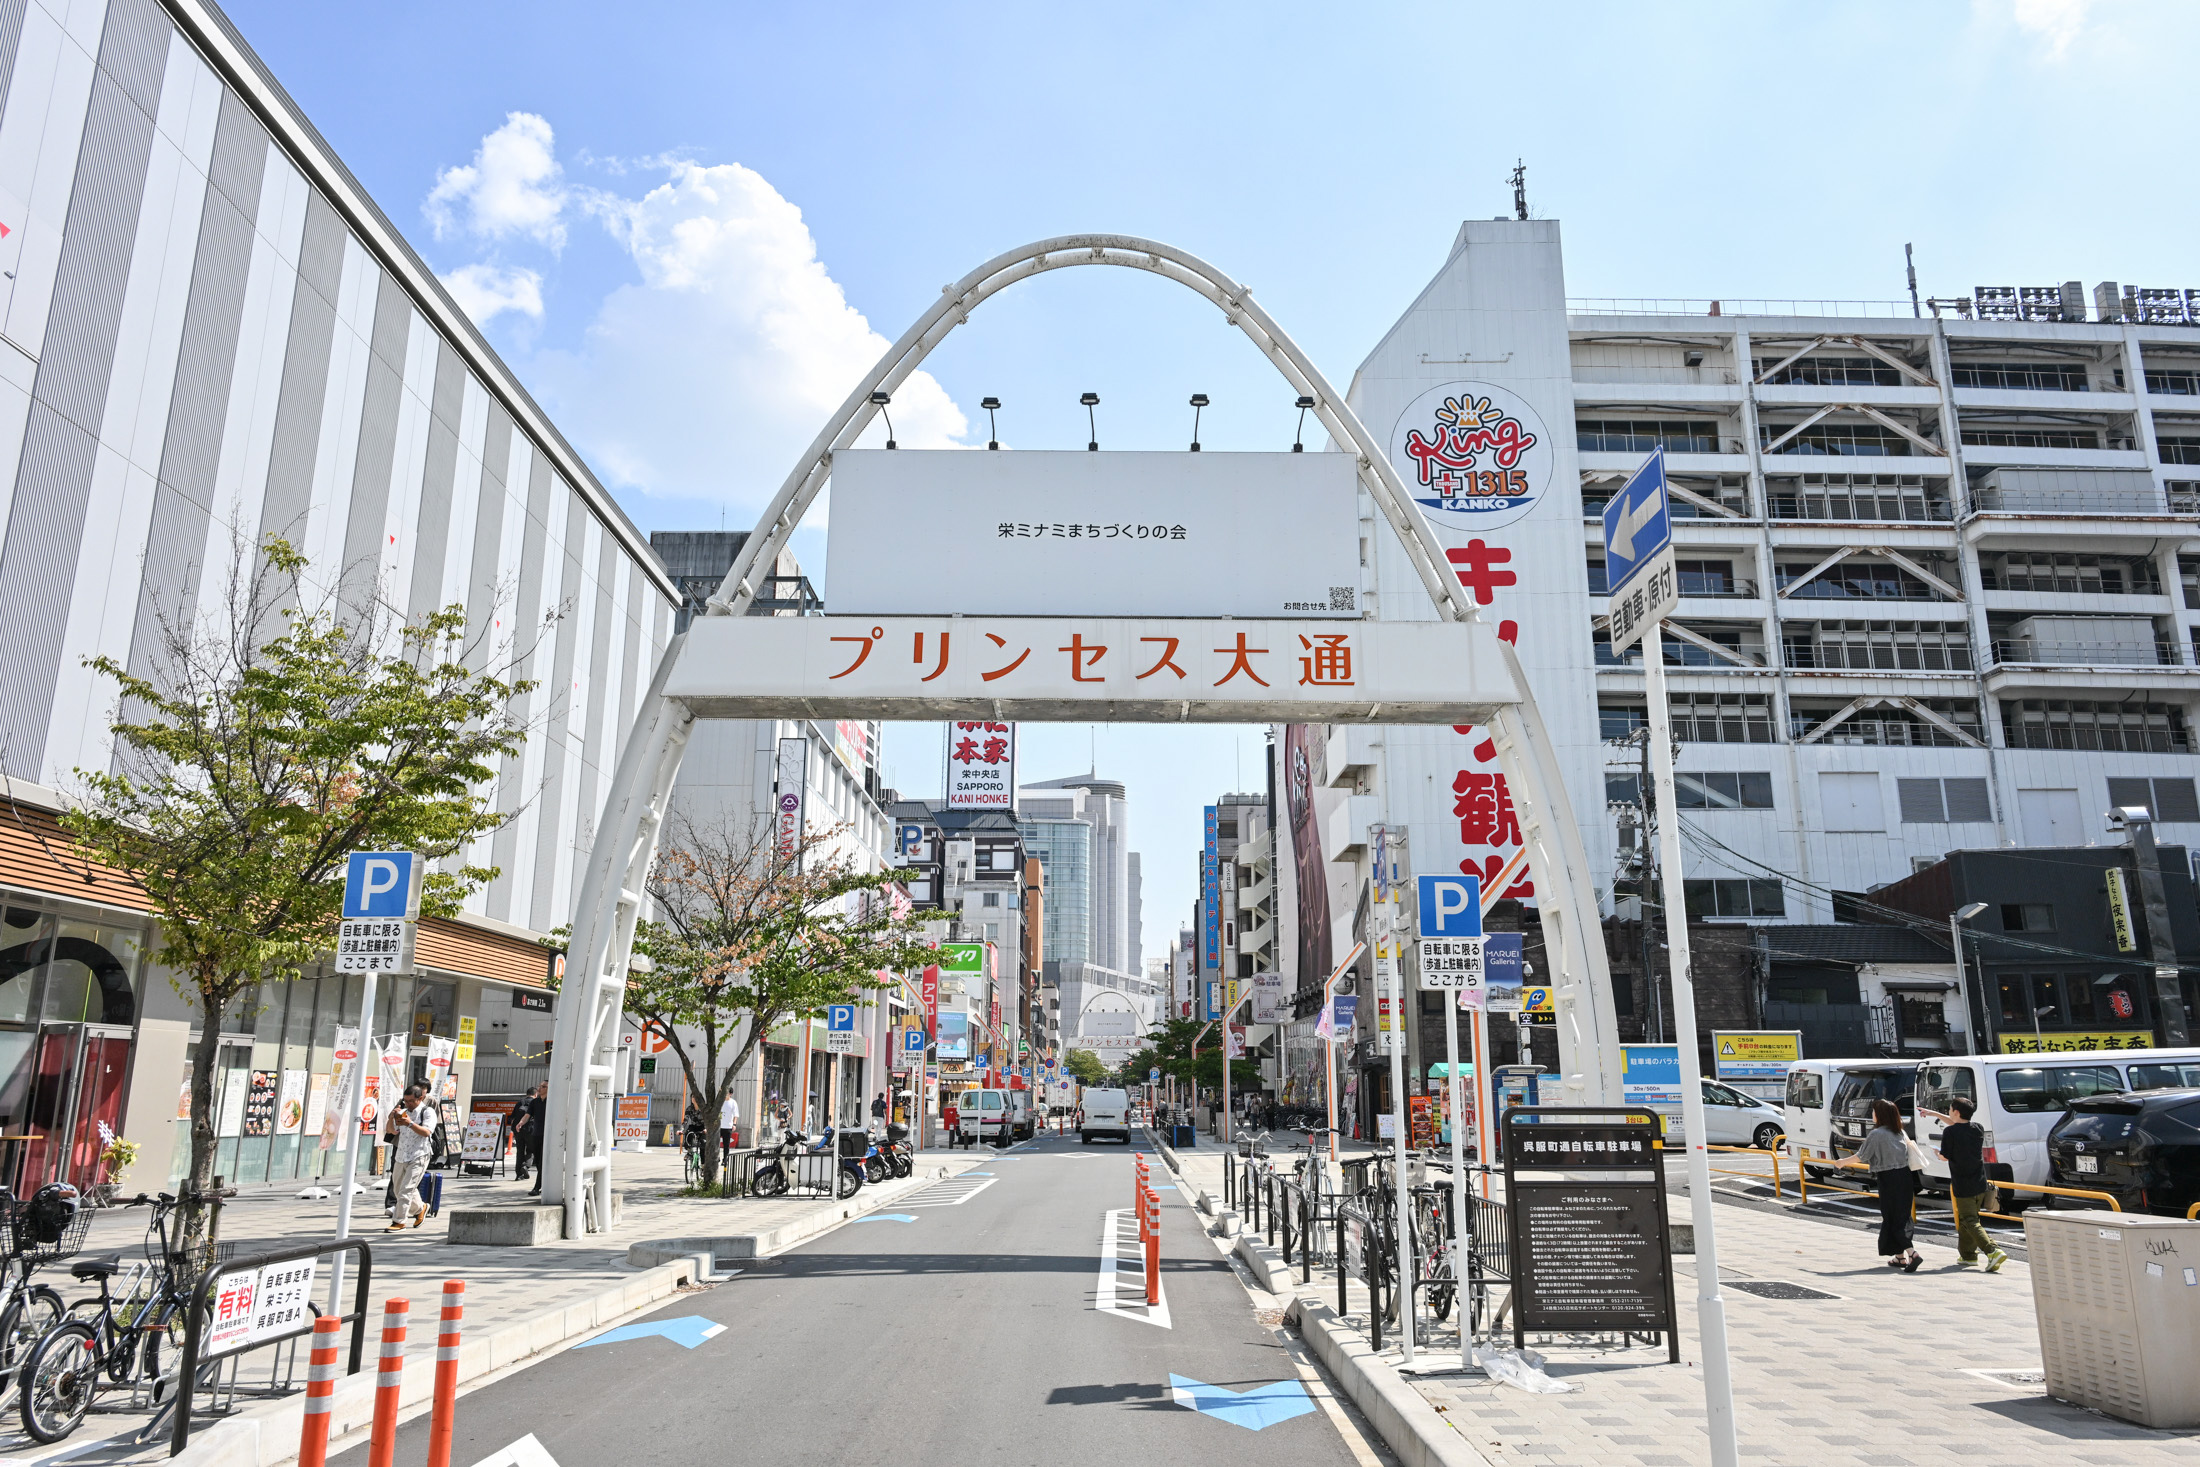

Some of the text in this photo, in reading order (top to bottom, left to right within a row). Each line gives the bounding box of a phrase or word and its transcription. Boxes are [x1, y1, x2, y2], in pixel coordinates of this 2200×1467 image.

[1405, 417, 1537, 486] King
[1464, 470, 1528, 497] 1315
[1442, 499, 1509, 510] KANKO
[998, 522, 1187, 541] 栄ミナミまちづくりの会
[1284, 602, 1326, 611] お問合せ先
[829, 626, 1356, 687] プリンセス大通
[962, 770, 999, 778] 栄中央店
[951, 794, 1008, 803] KANI HONKE
[902, 825, 922, 854] P
[360, 859, 399, 911] P
[1434, 882, 1469, 930] P
[343, 924, 400, 937] 自転車に限る
[951, 950, 977, 962] イク
[1424, 943, 1480, 955] 自転車に限る
[343, 957, 393, 969] ここまで
[1429, 975, 1477, 986] ここから
[834, 1008, 849, 1028] P
[1520, 1013, 1532, 1024] 空
[909, 1033, 920, 1048] P
[616, 1128, 641, 1137] 1200
[1523, 1141, 1642, 1152] 呉服町通自転車駐車場
[229, 1276, 249, 1287] こちらは
[266, 1268, 310, 1289] 自転車定期
[218, 1284, 253, 1321] 有料
[266, 1289, 301, 1308] 栄ミナミ
[257, 1307, 300, 1329] 呉服町通A
